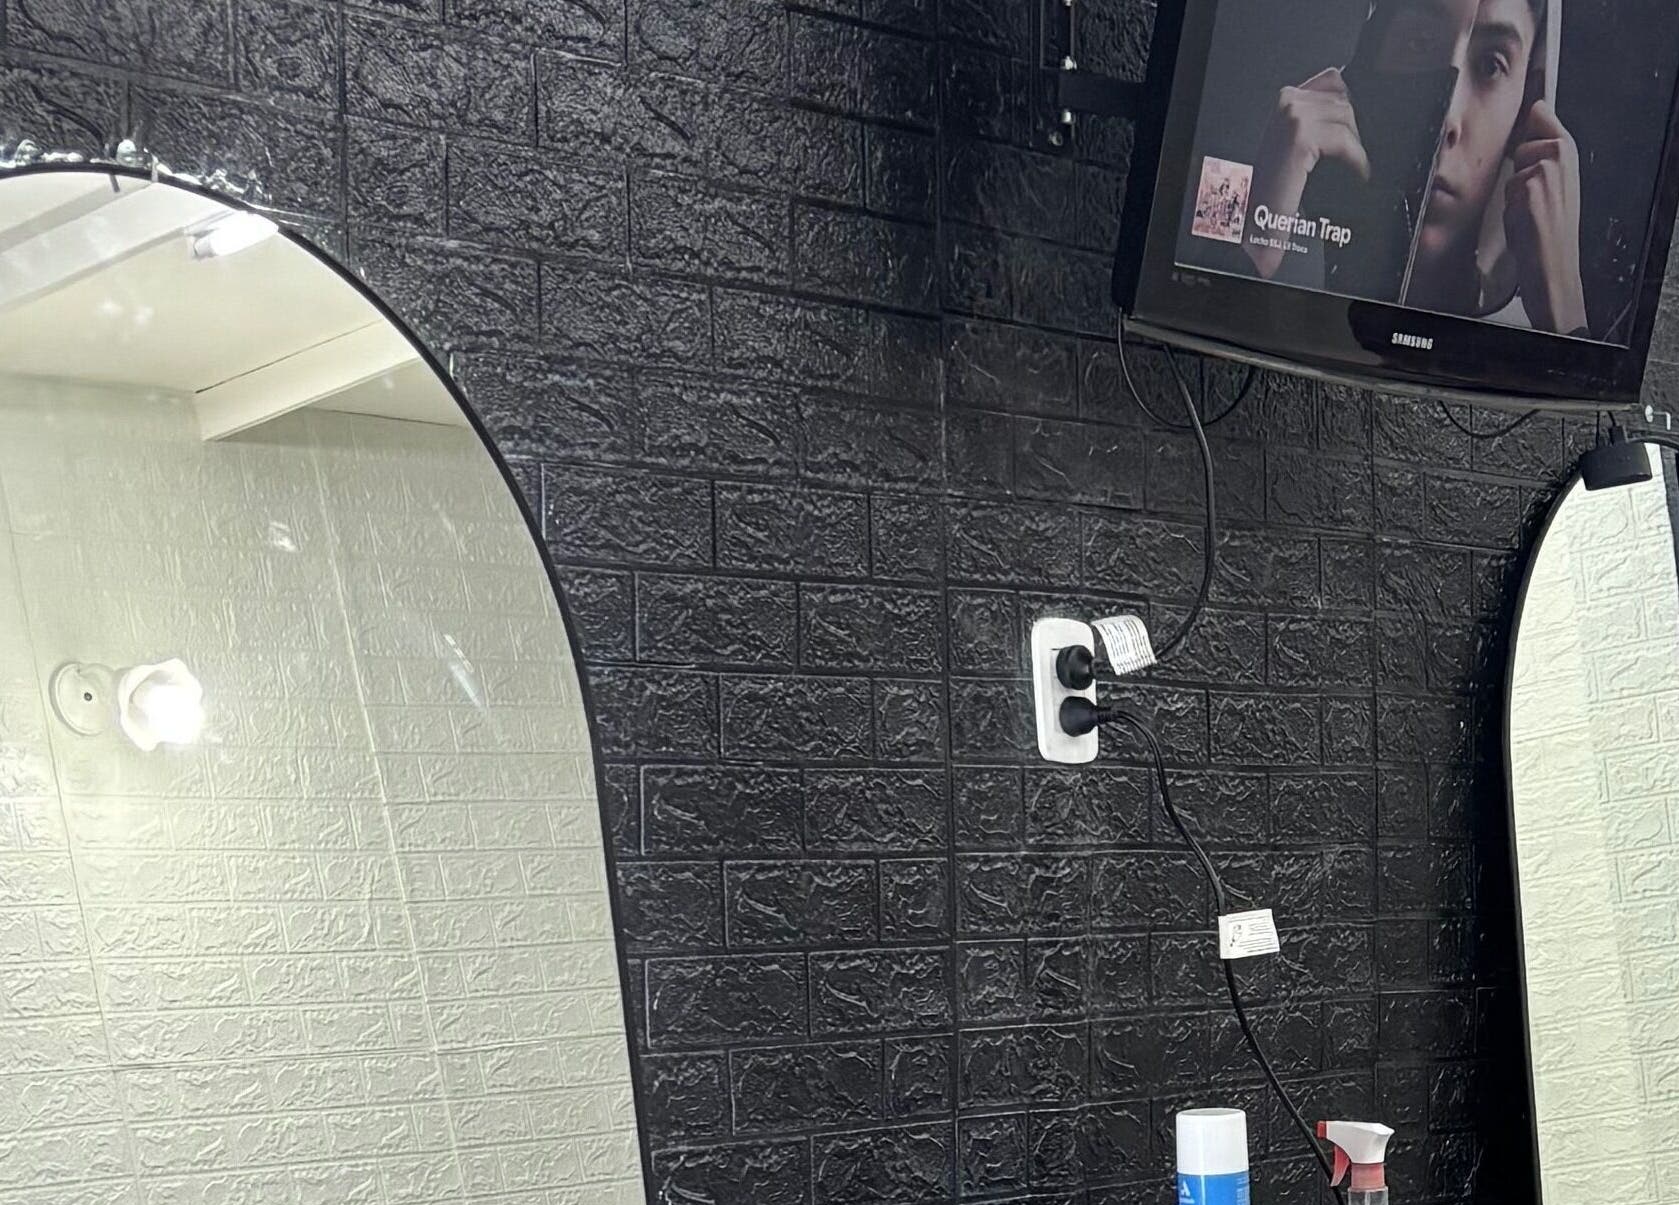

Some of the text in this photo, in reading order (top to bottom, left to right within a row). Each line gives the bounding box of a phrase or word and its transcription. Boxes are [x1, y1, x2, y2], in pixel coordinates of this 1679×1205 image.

[1254, 204, 1352, 248] Querian Trap
[1391, 332, 1434, 350] SAMSUNG
